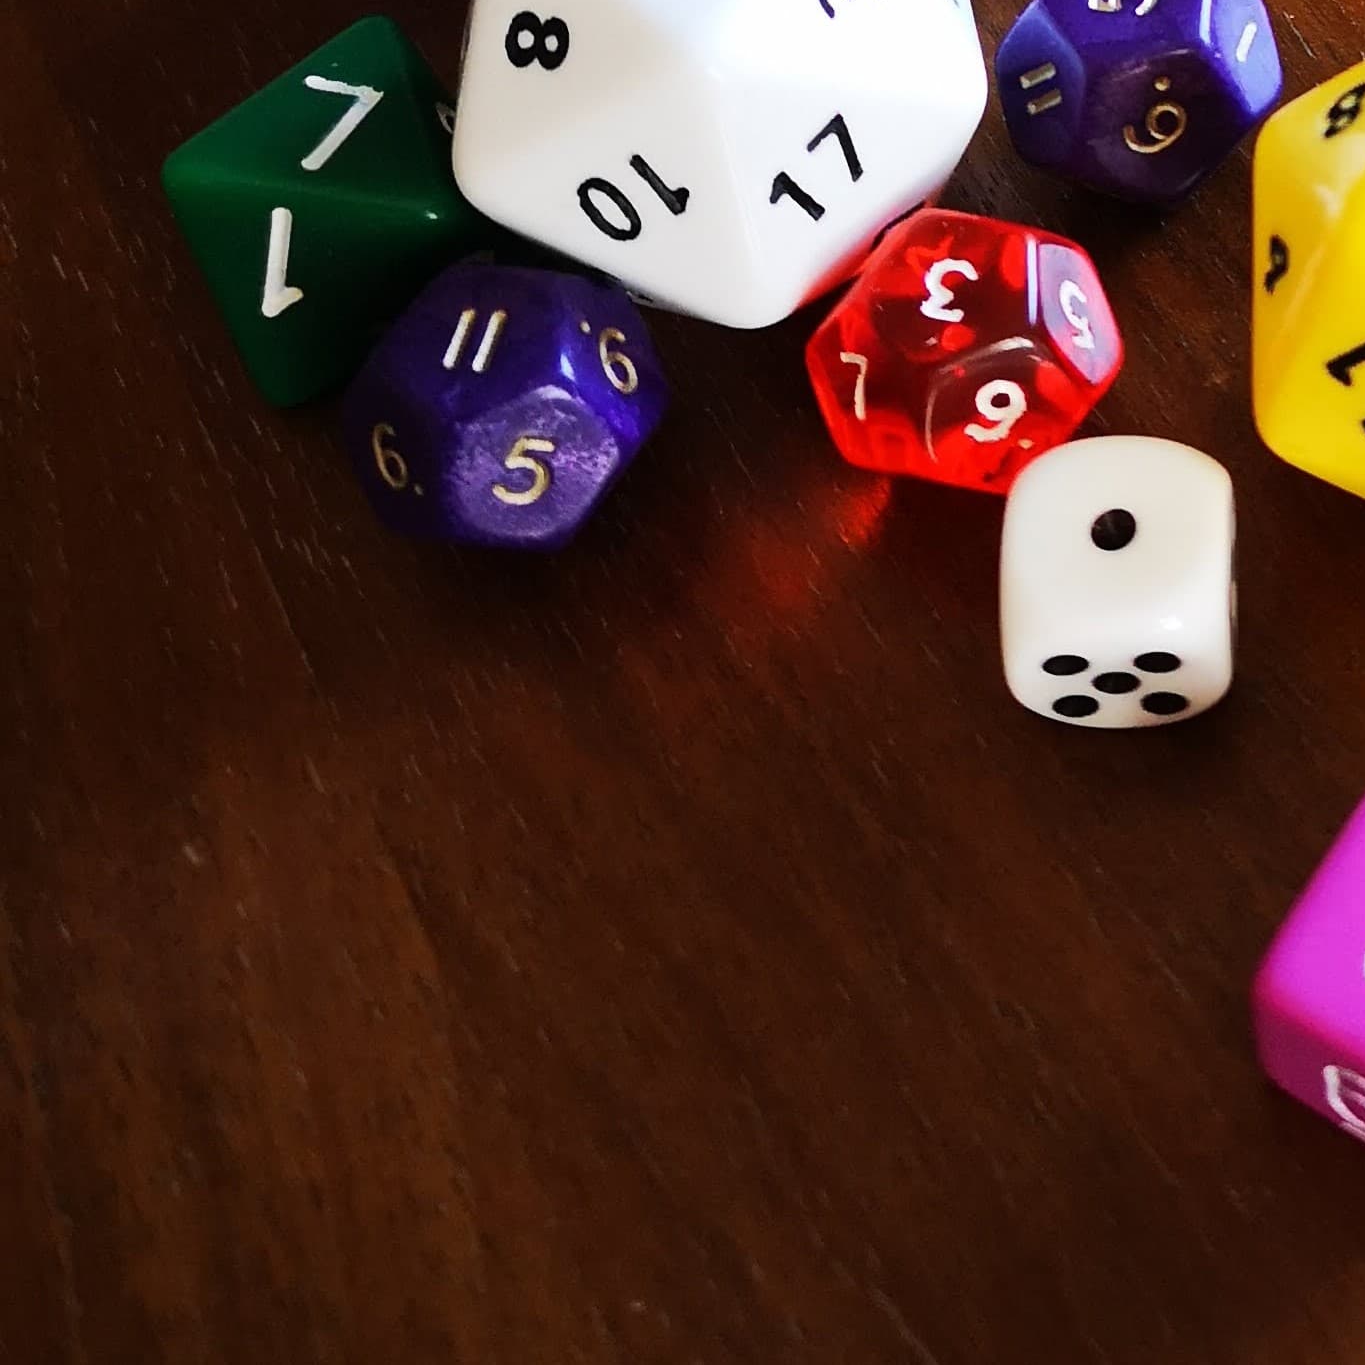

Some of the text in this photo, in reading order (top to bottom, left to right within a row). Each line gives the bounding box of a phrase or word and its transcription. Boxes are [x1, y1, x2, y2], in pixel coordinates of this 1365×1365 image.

[504, 11, 570, 71] 8
[1235, 21, 1258, 62] 1
[300, 75, 384, 172] 7
[1019, 62, 1062, 115] 11
[576, 154, 690, 241] 10
[769, 113, 864, 221] 17
[261, 206, 304, 318] 1
[919, 258, 979, 323] 3
[442, 307, 508, 373] 11
[839, 351, 869, 421] 7
[491, 435, 555, 506] 5
